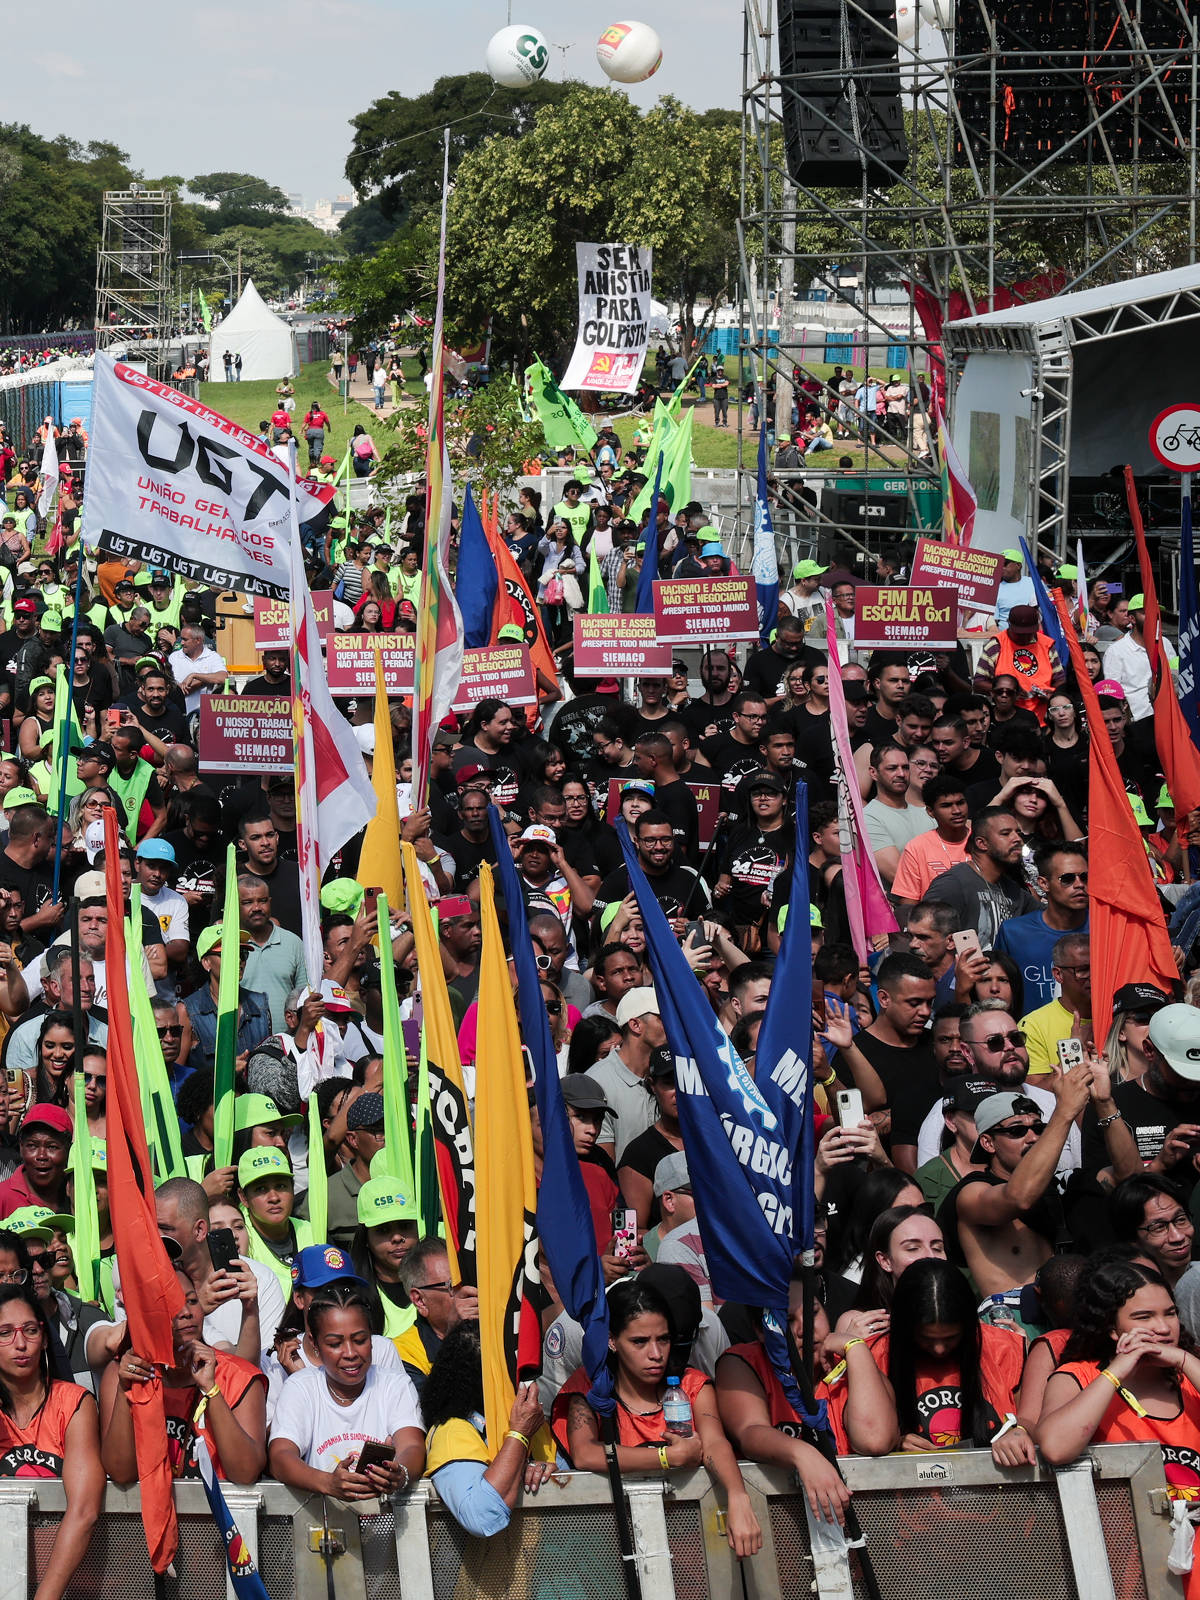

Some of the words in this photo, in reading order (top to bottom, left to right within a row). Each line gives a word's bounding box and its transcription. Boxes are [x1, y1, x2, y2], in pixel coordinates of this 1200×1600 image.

[596, 297, 642, 321] PARA
[123, 370, 159, 390] UGT
[159, 388, 194, 413] UGT
[195, 407, 228, 431] UGT
[229, 427, 264, 450] UGT
[136, 409, 299, 522] UGT
[137, 476, 185, 505] UNIÃO
[242, 530, 275, 549] DOS
[923, 543, 959, 560] RACISMO
[960, 551, 966, 560] E
[967, 552, 998, 567] ASSÉDIO
[109, 536, 138, 556] UGT
[141, 547, 172, 567] UGT
[174, 557, 199, 577] UGT
[204, 568, 240, 588] UGT
[245, 578, 271, 597] UGT
[940, 557, 952, 568] SE
[952, 560, 995, 577] NEGOCIAM!
[955, 572, 971, 582] TODO
[660, 583, 700, 595] RACISMO
[702, 584, 709, 593] E
[710, 580, 748, 592] ASSÉDIO
[662, 594, 680, 605] NÃO
[683, 594, 694, 604] SE
[696, 591, 747, 604] NEGOCIAM!
[878, 589, 907, 606] FIM
[912, 589, 934, 606] DA
[662, 606, 700, 615] #RESPEITE
[702, 605, 721, 613] TODO
[722, 602, 750, 612] MUNDO
[862, 605, 920, 622] ESCALA
[925, 606, 950, 622] 6x1
[259, 610, 289, 625] ESCA
[580, 619, 619, 629] RACISMO
[621, 619, 626, 628] E
[685, 617, 730, 629] SIEMACO
[582, 628, 600, 638] NÃO
[602, 628, 613, 638] SE
[884, 625, 929, 636] SIEMACO
[333, 636, 362, 650] SEM
[366, 635, 415, 650] ANISTIA
[581, 640, 618, 648] #RESPEITE
[620, 640, 637, 648] TODO
[336, 651, 358, 660] QUEM
[383, 651, 388, 660] O
[390, 651, 413, 660] GOLPE
[481, 652, 487, 661] E
[488, 647, 522, 660] ASSÉDIO
[602, 652, 645, 663] SIEMACO
[336, 658, 351, 668] NÃO
[385, 658, 413, 668] PERDÃO
[463, 663, 475, 673] SE
[476, 659, 522, 673] NEGOCIAM!
[482, 672, 499, 681] TODO
[501, 669, 525, 679] MUNDO
[467, 684, 508, 697] SIEMACO
[210, 697, 290, 717] VALORIZAÇÃO
[216, 717, 223, 726] O
[225, 717, 254, 727] NOSSO
[223, 728, 249, 738] MOVE
[251, 728, 258, 738] O
[234, 744, 286, 757] SIEMACO
[722, 773, 740, 786] 24
[695, 785, 710, 801] JÁ
[731, 860, 752, 875] 24
[176, 878, 196, 891] 24
[251, 1157, 269, 1167] CSB
[373, 1195, 394, 1206] CSB
[5, 1220, 25, 1232] CSB
[316, 1435, 342, 1455] CAMPANHA
[342, 1432, 350, 1441] DE
[5, 1449, 57, 1470] FORÇA
[918, 1469, 949, 1479] alutent
